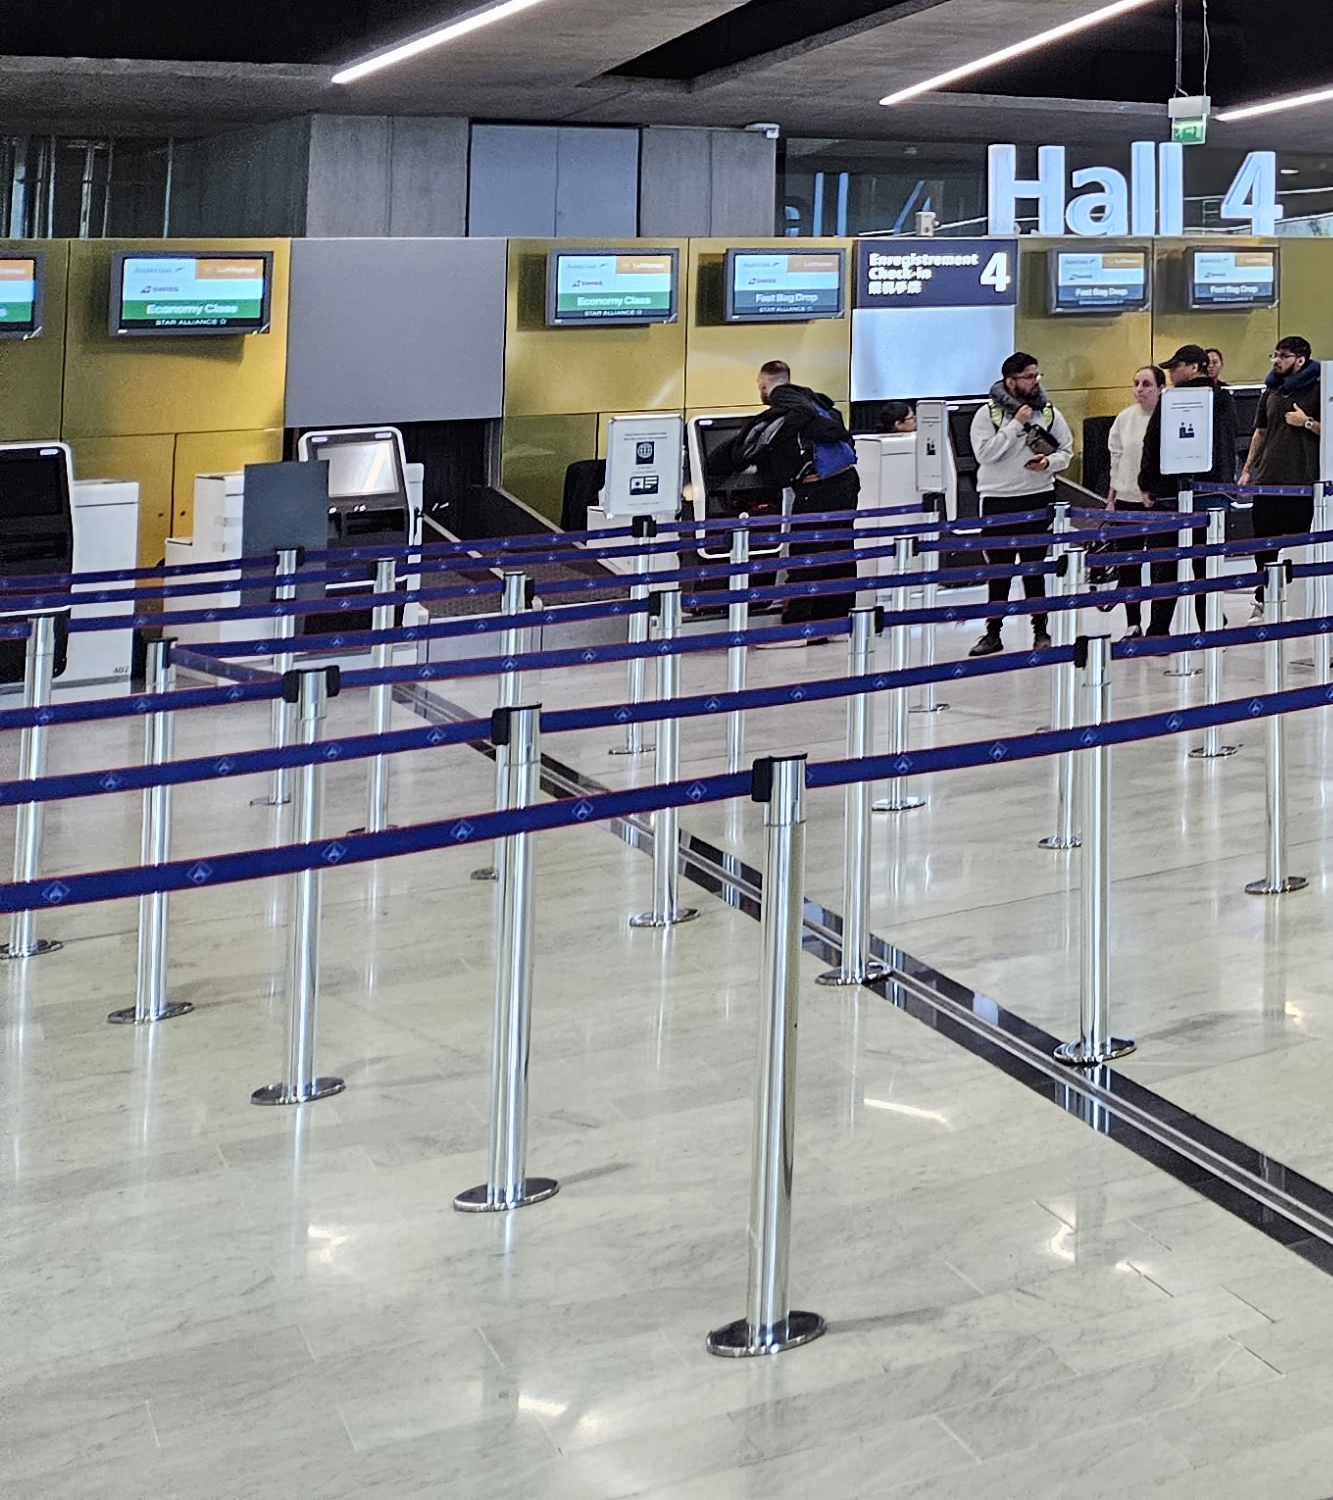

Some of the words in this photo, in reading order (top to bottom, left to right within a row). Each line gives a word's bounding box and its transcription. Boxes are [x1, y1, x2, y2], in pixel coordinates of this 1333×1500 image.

[988, 141, 1184, 237] Hall
[1221, 151, 1284, 237] 4
[868, 253, 979, 269] Enregistrement
[980, 252, 1011, 292] 4
[868, 266, 932, 280] Check-in
[577, 296, 623, 307] Economy
[624, 296, 652, 305] Class
[755, 293, 775, 303] Fast
[776, 293, 794, 304] Bag
[795, 293, 818, 303] Drop
[146, 304, 204, 315] Economy
[204, 303, 239, 314] Class
